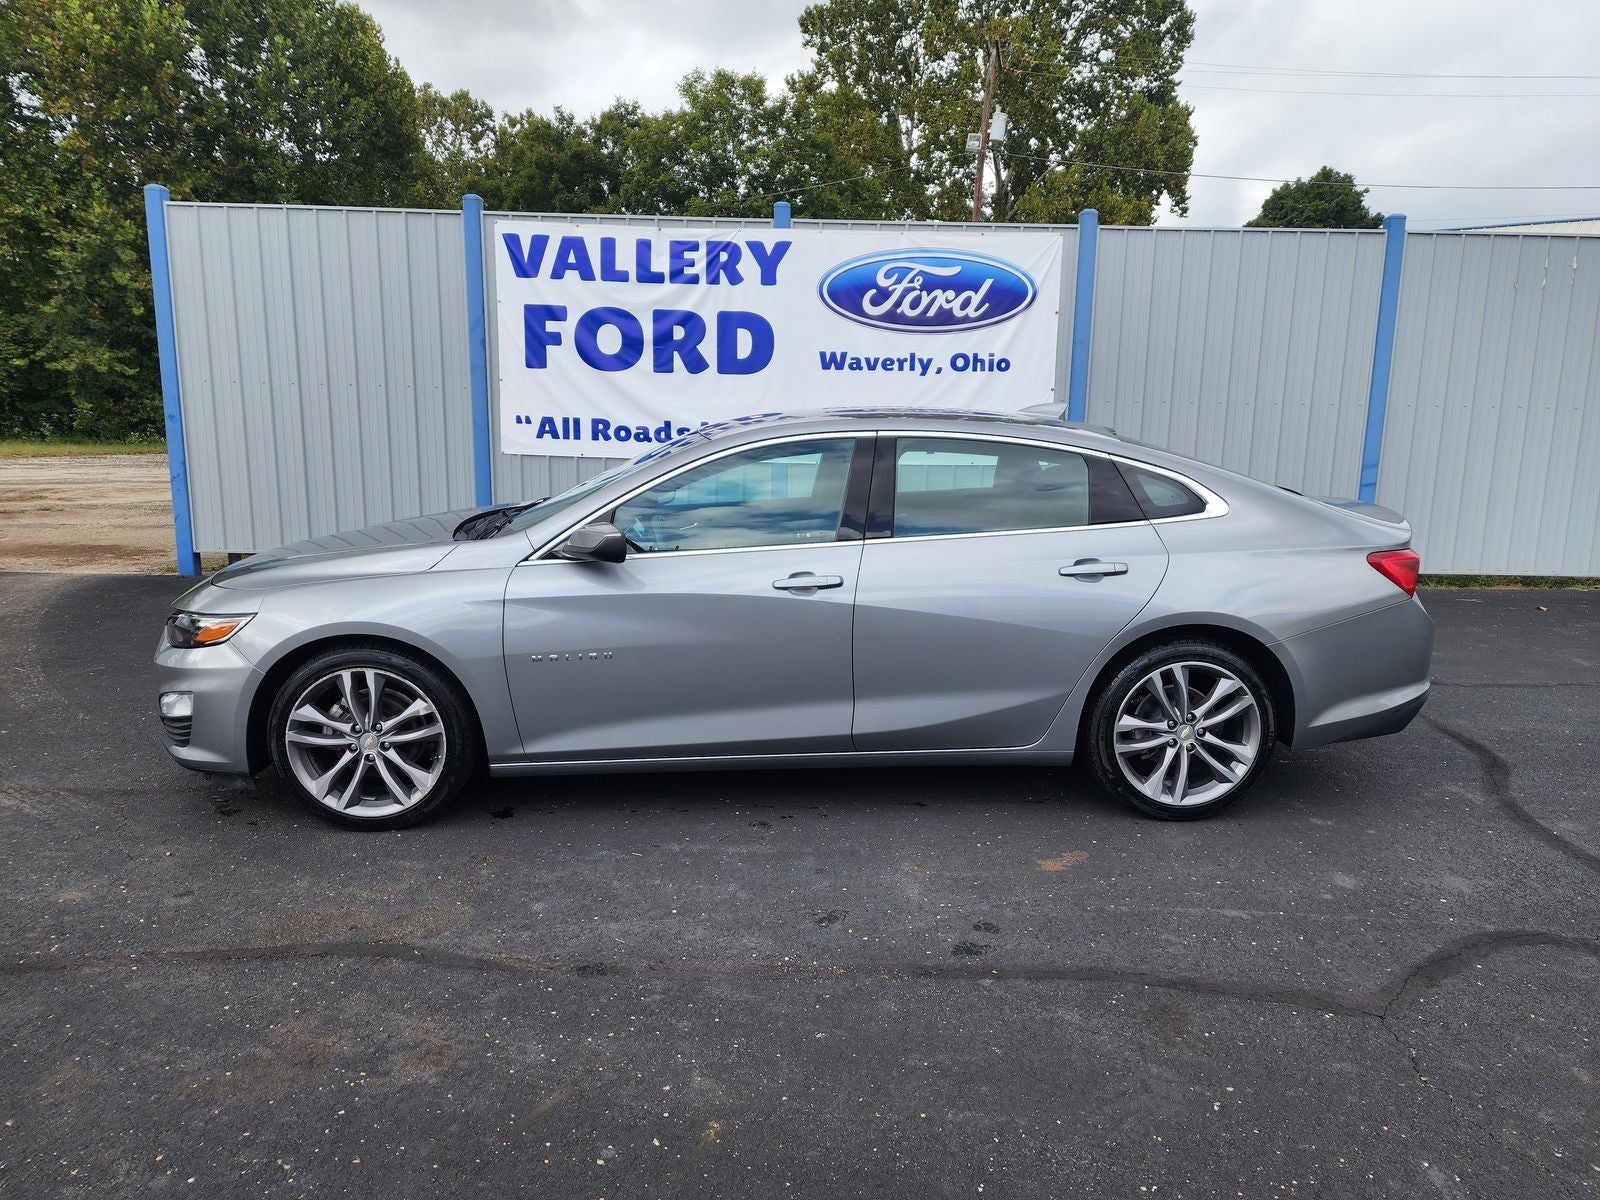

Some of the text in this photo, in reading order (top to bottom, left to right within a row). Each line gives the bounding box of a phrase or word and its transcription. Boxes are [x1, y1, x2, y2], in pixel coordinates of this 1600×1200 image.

[502, 232, 793, 287] VALLERY
[862, 262, 994, 318] Ford
[524, 303, 775, 375] FORD
[818, 351, 1011, 377] Waverly, Ohio
